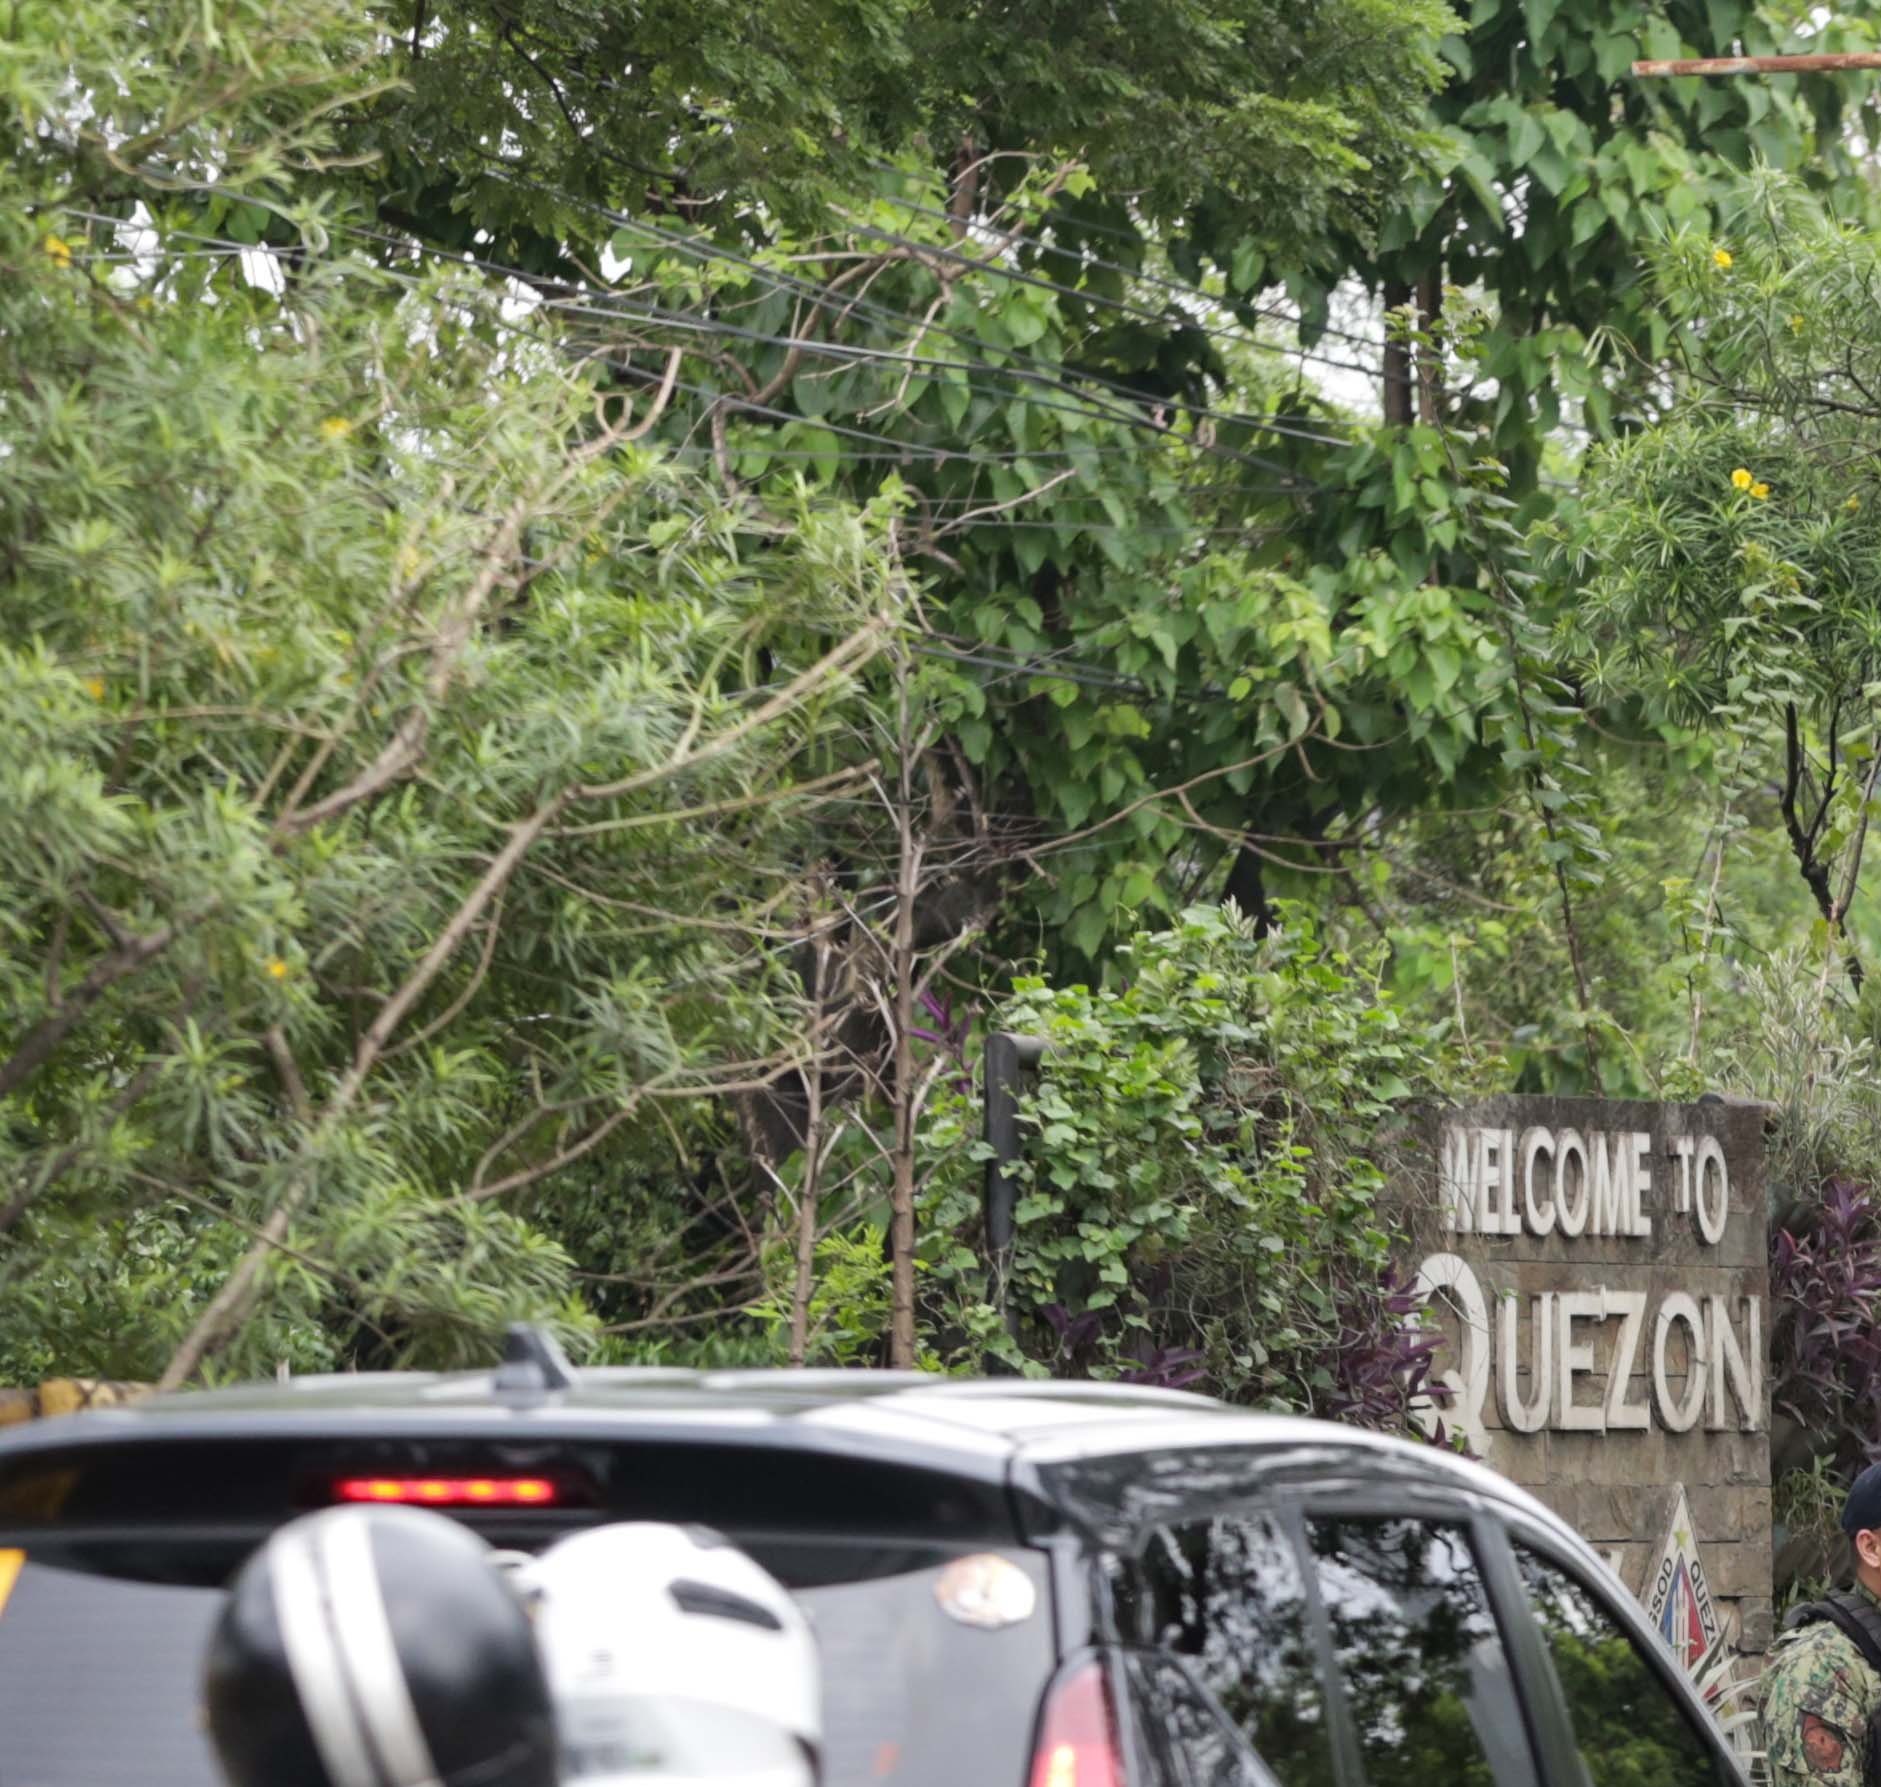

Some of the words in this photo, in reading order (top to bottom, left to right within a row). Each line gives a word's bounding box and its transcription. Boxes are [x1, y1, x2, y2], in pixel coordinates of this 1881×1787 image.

[1441, 1125, 1652, 1237] WELCOME
[1671, 1134, 1729, 1245] TO
[1408, 1253, 1761, 1456] QUEZON
